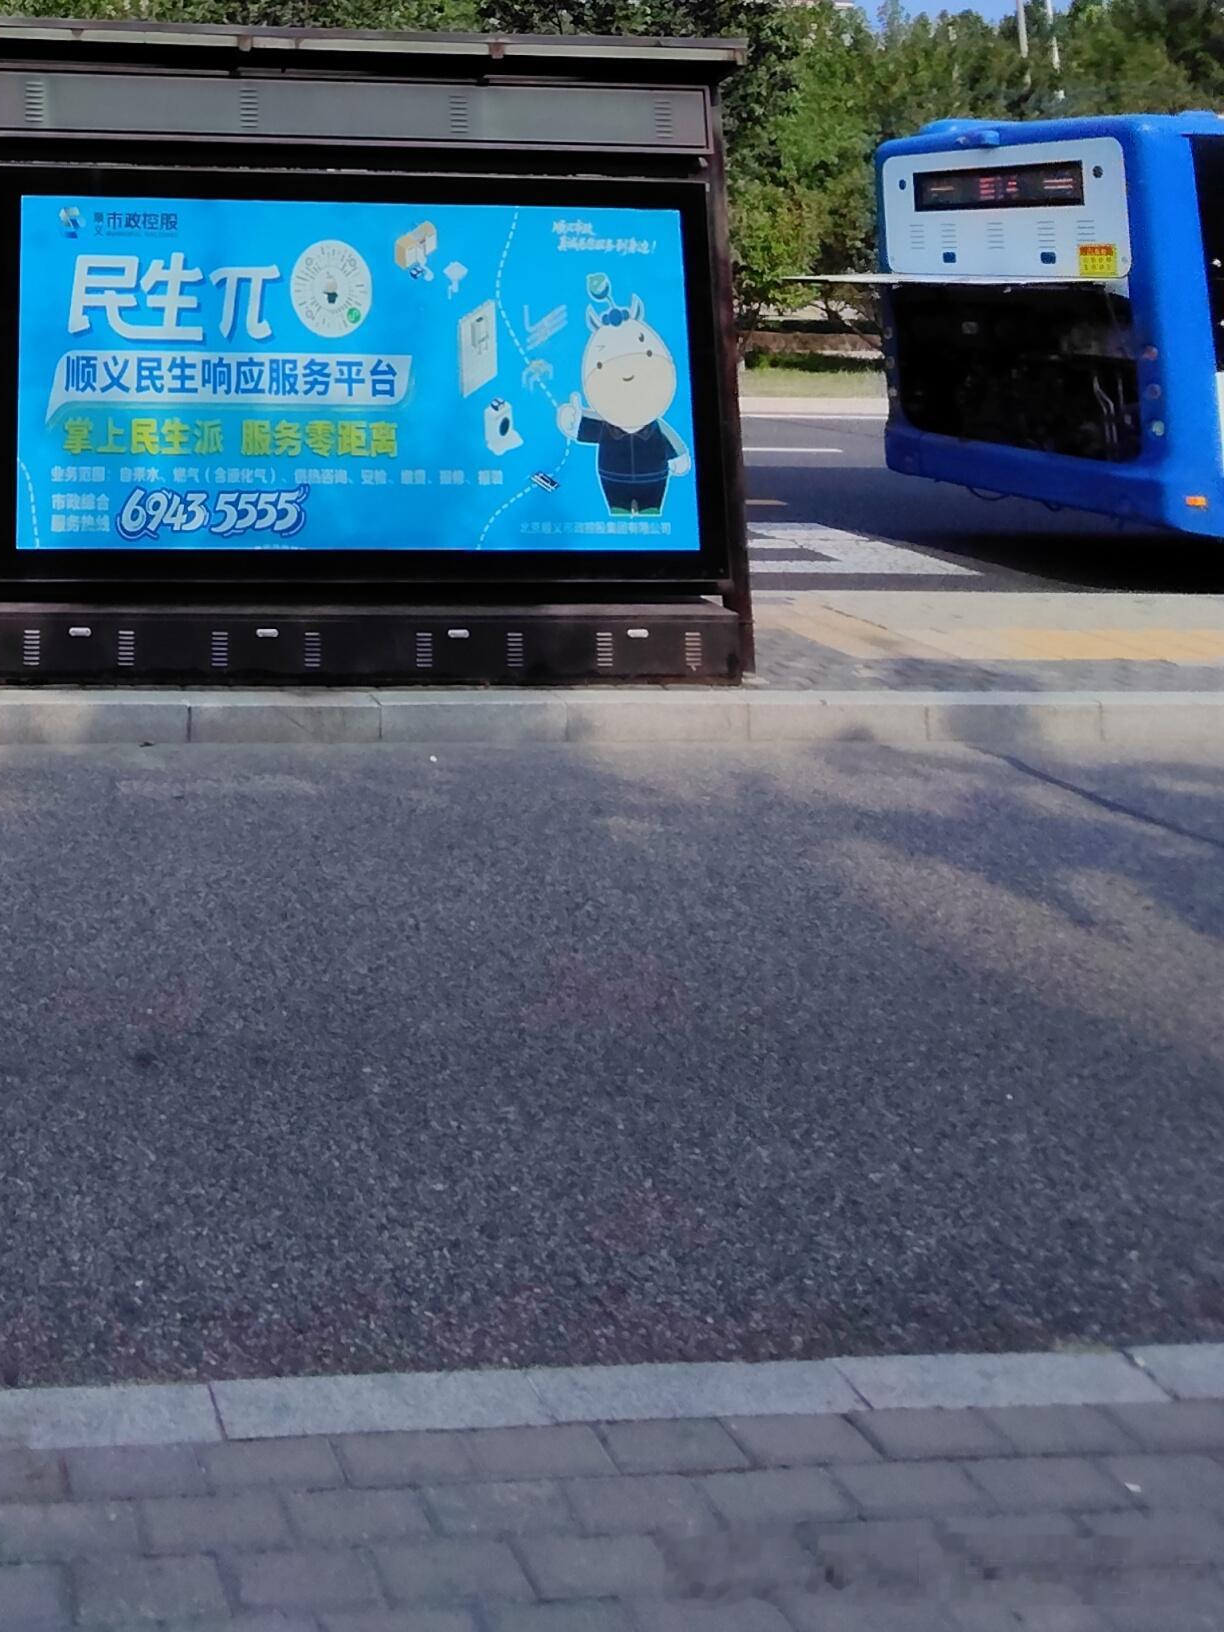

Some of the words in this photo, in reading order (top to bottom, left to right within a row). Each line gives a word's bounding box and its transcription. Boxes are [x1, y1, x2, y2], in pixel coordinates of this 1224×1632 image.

[106, 211, 178, 230] 市政控股
[64, 355, 398, 398] 顺义民生响应服务平台
[63, 417, 224, 455] 掌上民生派
[241, 420, 398, 458] 服务零距离
[121, 489, 206, 532] 6943
[210, 489, 301, 533] 5555
